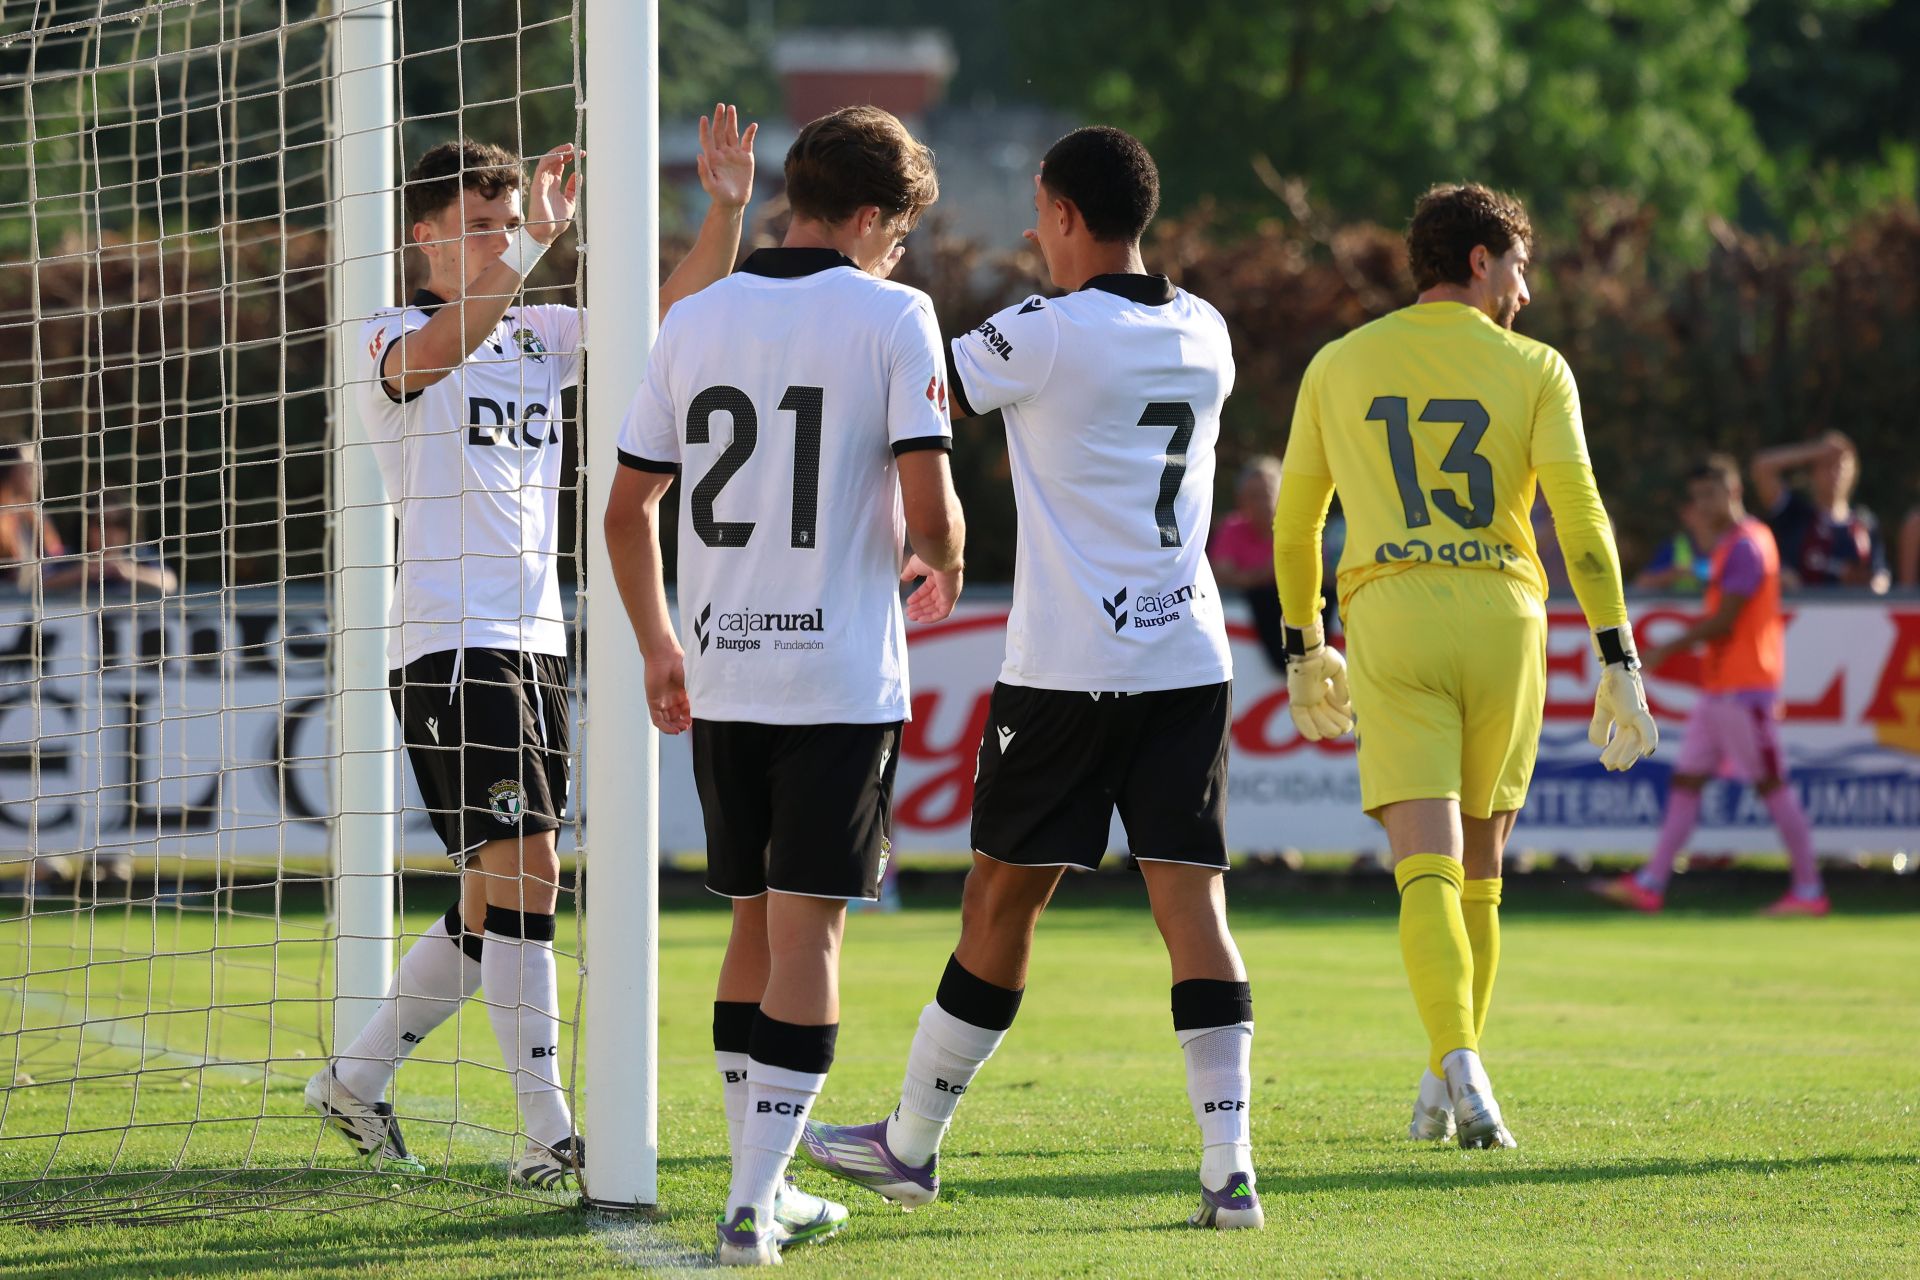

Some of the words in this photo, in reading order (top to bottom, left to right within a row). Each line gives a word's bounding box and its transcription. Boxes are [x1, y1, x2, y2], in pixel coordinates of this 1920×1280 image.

[685, 385, 824, 549] 21
[1365, 395, 1495, 529] 13
[1136, 402, 1196, 547] 7
[718, 607, 825, 638] cajarural
[1133, 611, 1180, 628] Burgos
[715, 637, 761, 653] Burgos
[773, 640, 824, 650] Fundación
[757, 1101, 805, 1117] BCF
[1204, 1100, 1245, 1113] BCF
